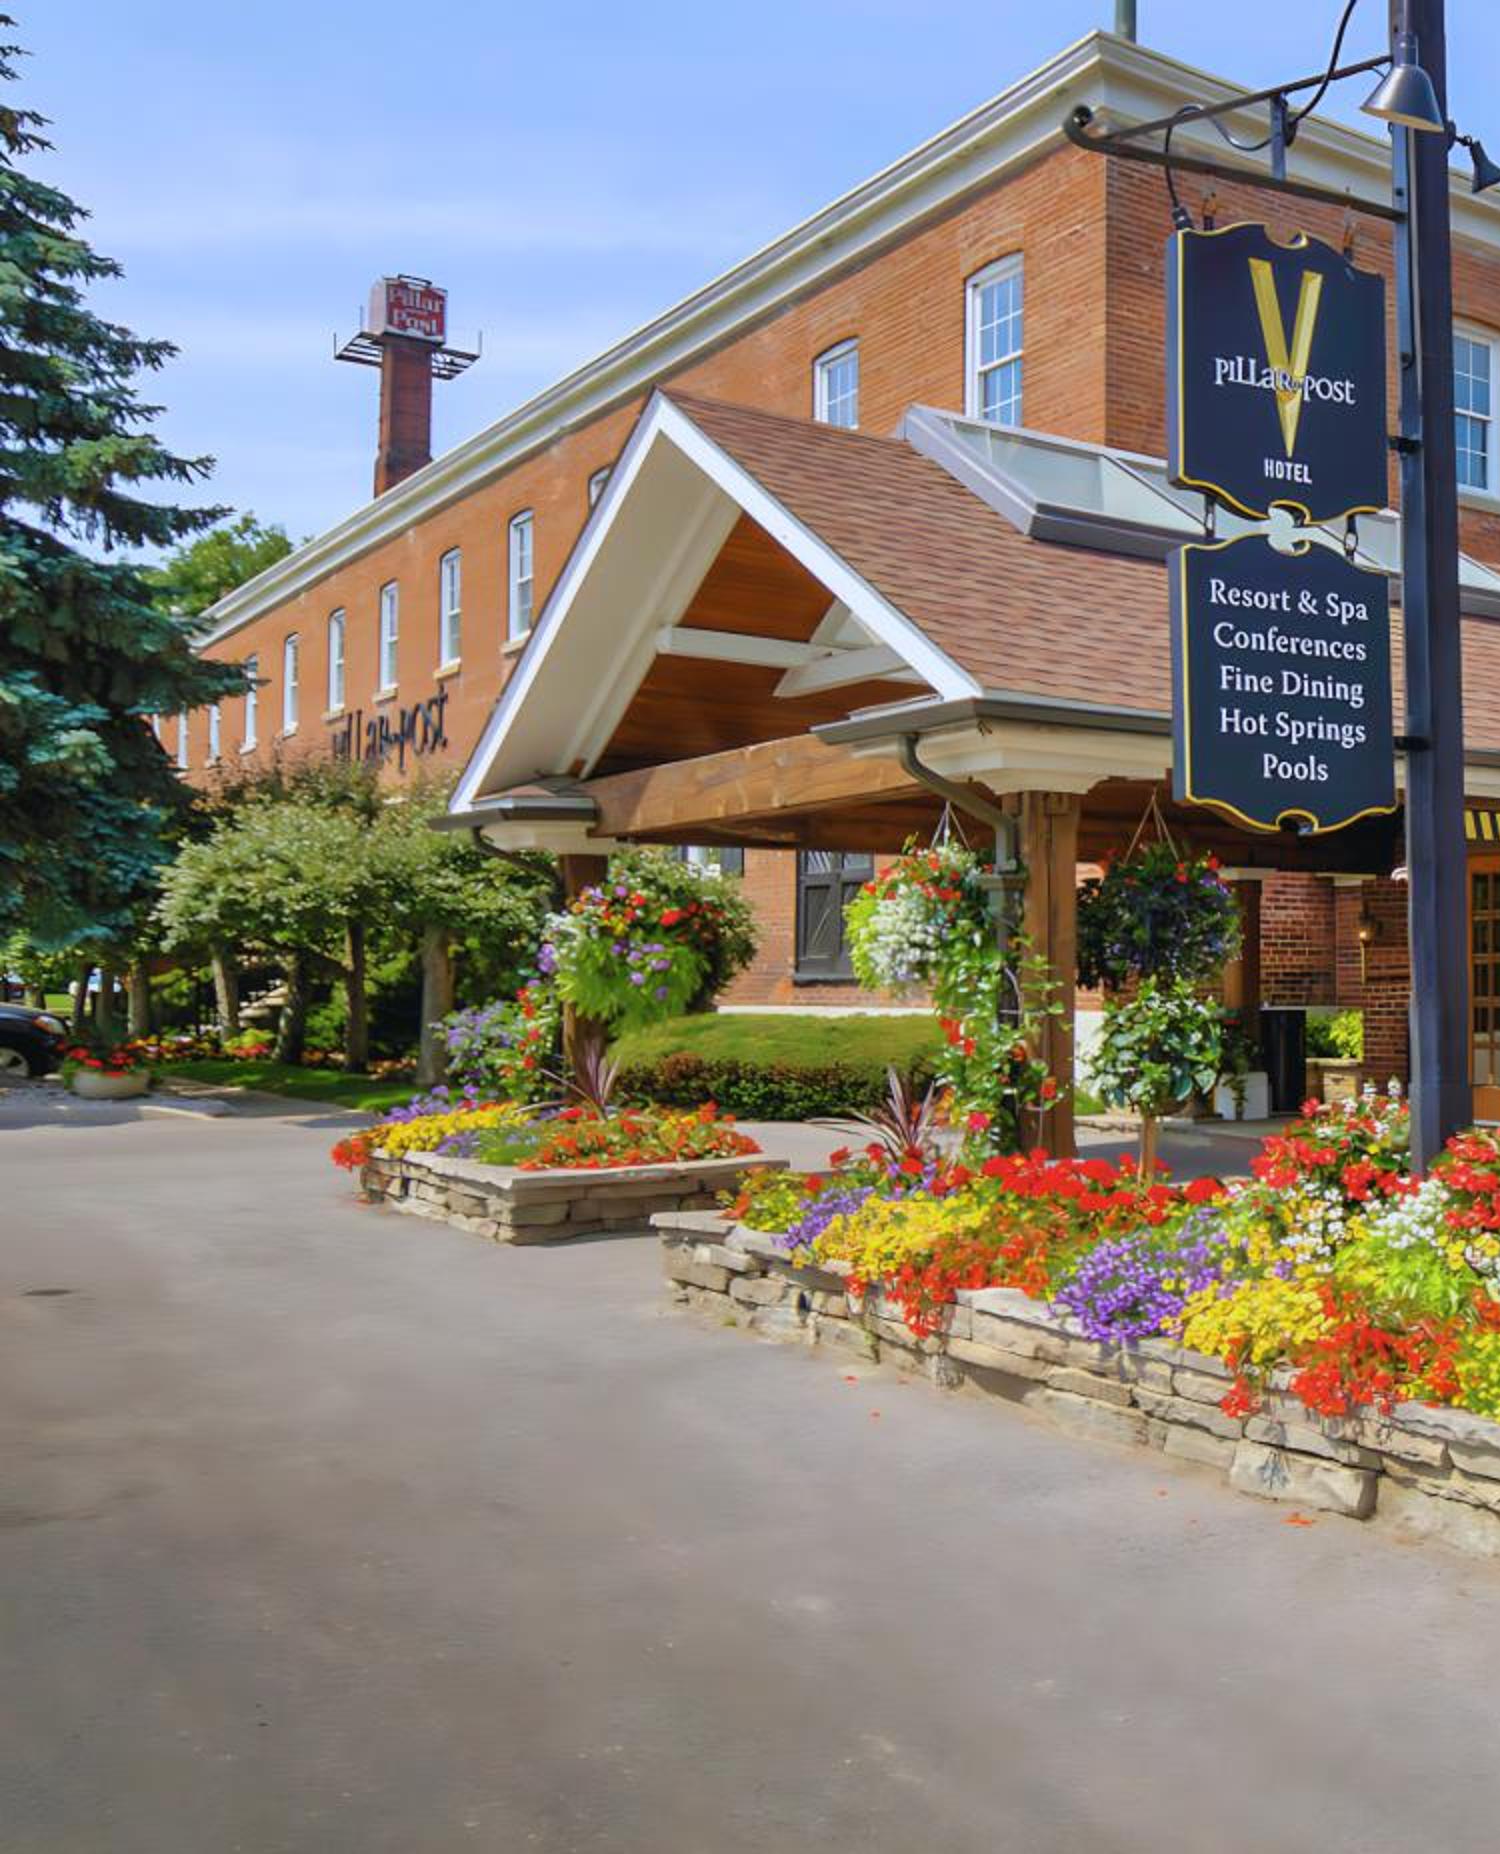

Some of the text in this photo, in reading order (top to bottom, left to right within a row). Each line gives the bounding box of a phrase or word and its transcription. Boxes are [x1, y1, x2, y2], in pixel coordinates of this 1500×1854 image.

[388, 287, 442, 312] Pillar
[392, 308, 437, 333] Post
[1263, 457, 1312, 484] HOTEL
[1209, 577, 1369, 625] Resort & Spa
[1213, 621, 1367, 661] Conferences
[1220, 665, 1365, 709] Fine Dining
[1219, 707, 1367, 749] Hot Springs
[1263, 753, 1329, 782] Pools
